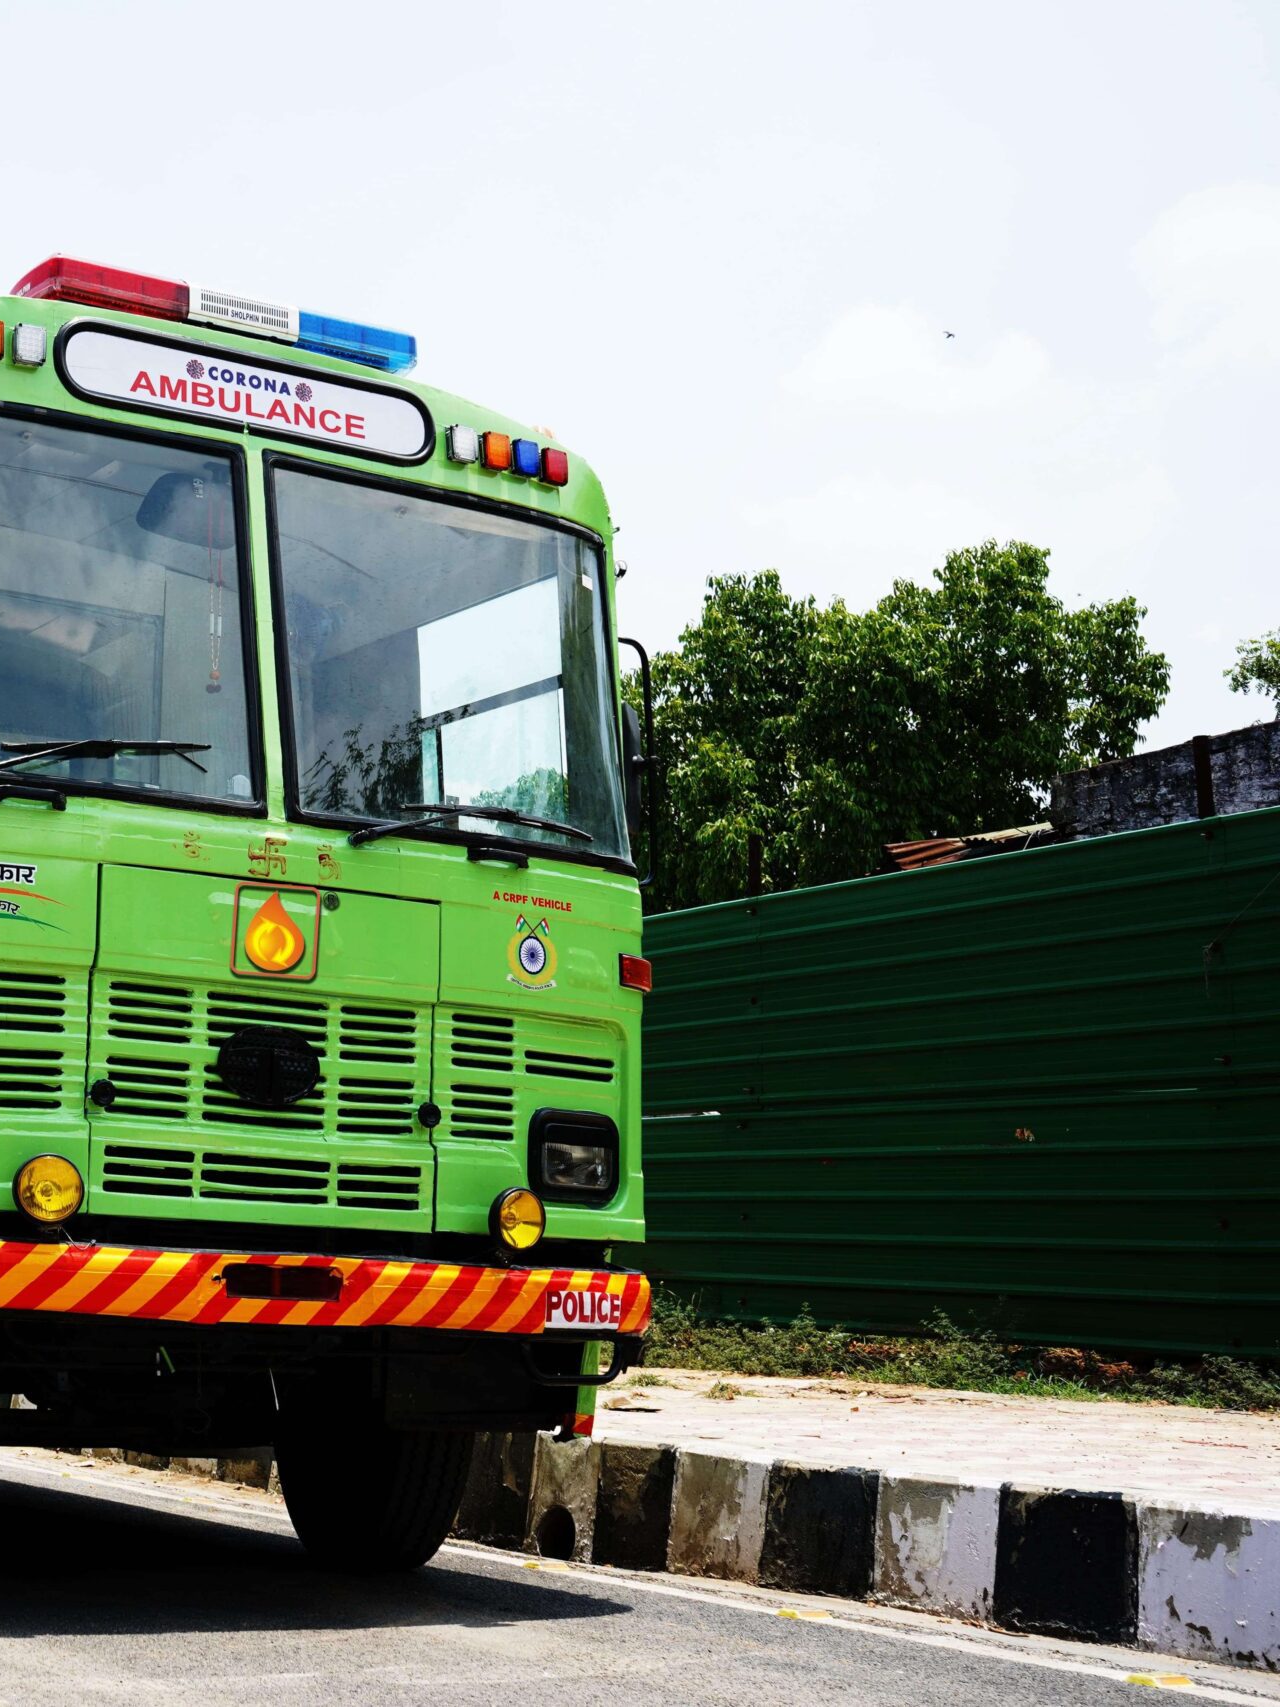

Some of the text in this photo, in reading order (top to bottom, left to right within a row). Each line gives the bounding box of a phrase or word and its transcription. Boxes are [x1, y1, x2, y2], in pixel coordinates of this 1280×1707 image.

[230, 309, 259, 322] SHOLPHIN
[208, 366, 291, 397] CORONA
[130, 371, 366, 439] AMBULANCE
[493, 890, 572, 912] A CRPF VEHICLE
[546, 1290, 620, 1324] POLICE
